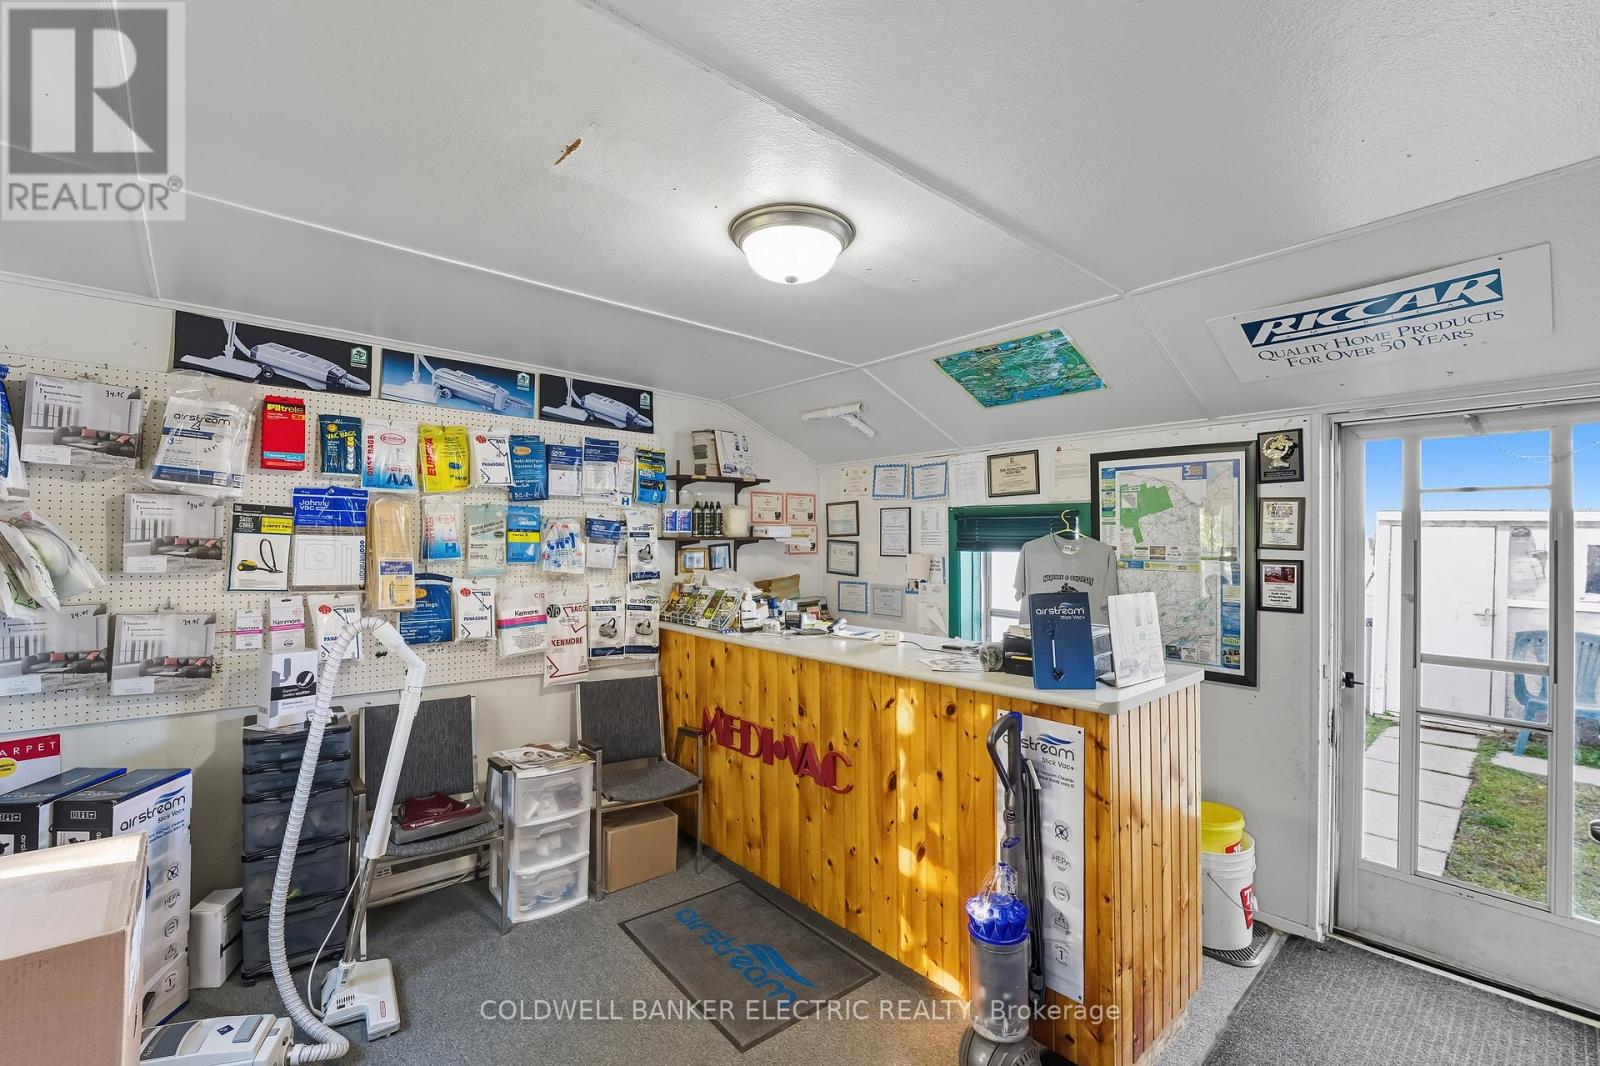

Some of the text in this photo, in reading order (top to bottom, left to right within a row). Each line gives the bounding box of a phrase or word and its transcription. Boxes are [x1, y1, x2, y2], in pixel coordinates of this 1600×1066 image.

[1251, 273, 1502, 345] RICCAR
[1380, 339, 1406, 353] 50
[173, 412, 231, 427] airstream
[515, 609, 538, 617] Kenmore
[1035, 606, 1085, 615] airstream
[551, 636, 583, 647] KENMORE
[1003, 735, 1075, 761] astream
[120, 795, 186, 832] airstream
[673, 907, 798, 1008] airstream
